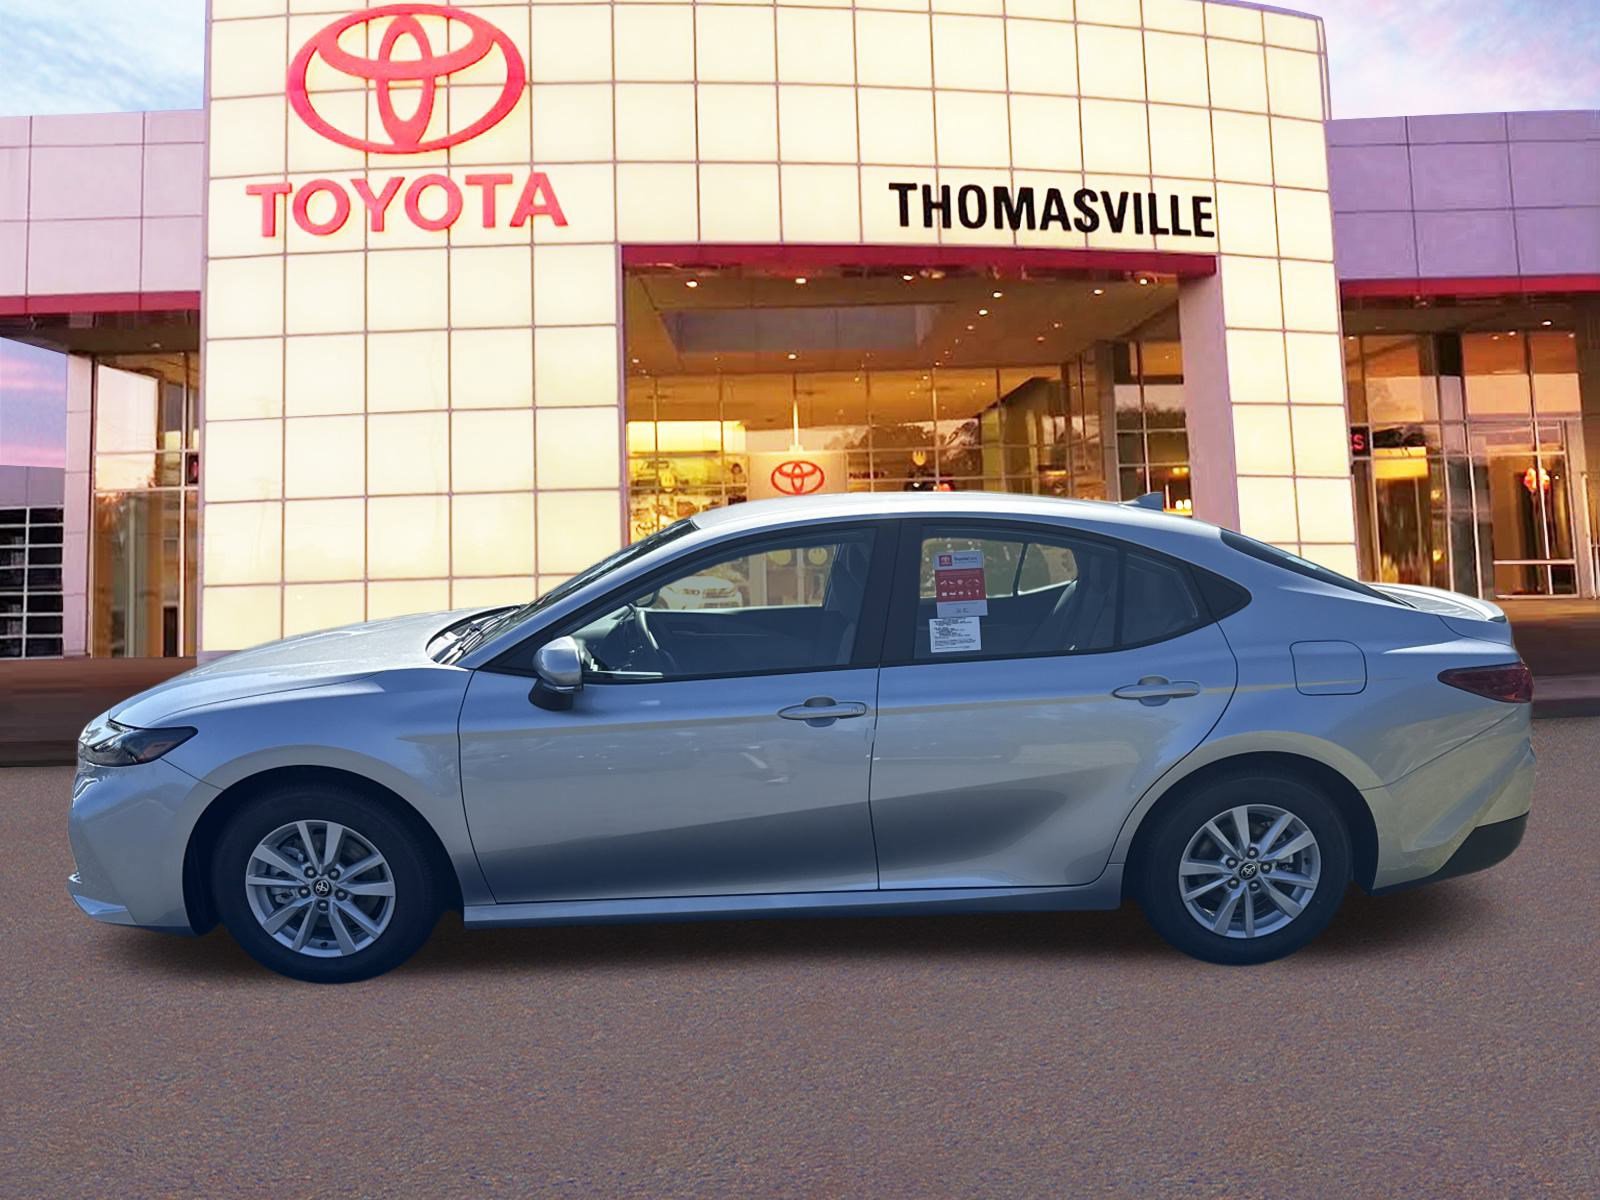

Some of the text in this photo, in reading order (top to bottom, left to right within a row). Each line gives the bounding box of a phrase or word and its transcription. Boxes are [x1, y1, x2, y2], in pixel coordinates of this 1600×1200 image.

[246, 172, 568, 237] TOYOTA
[888, 182, 1215, 238] THOMASVILLE
[1350, 434, 1365, 450] S
